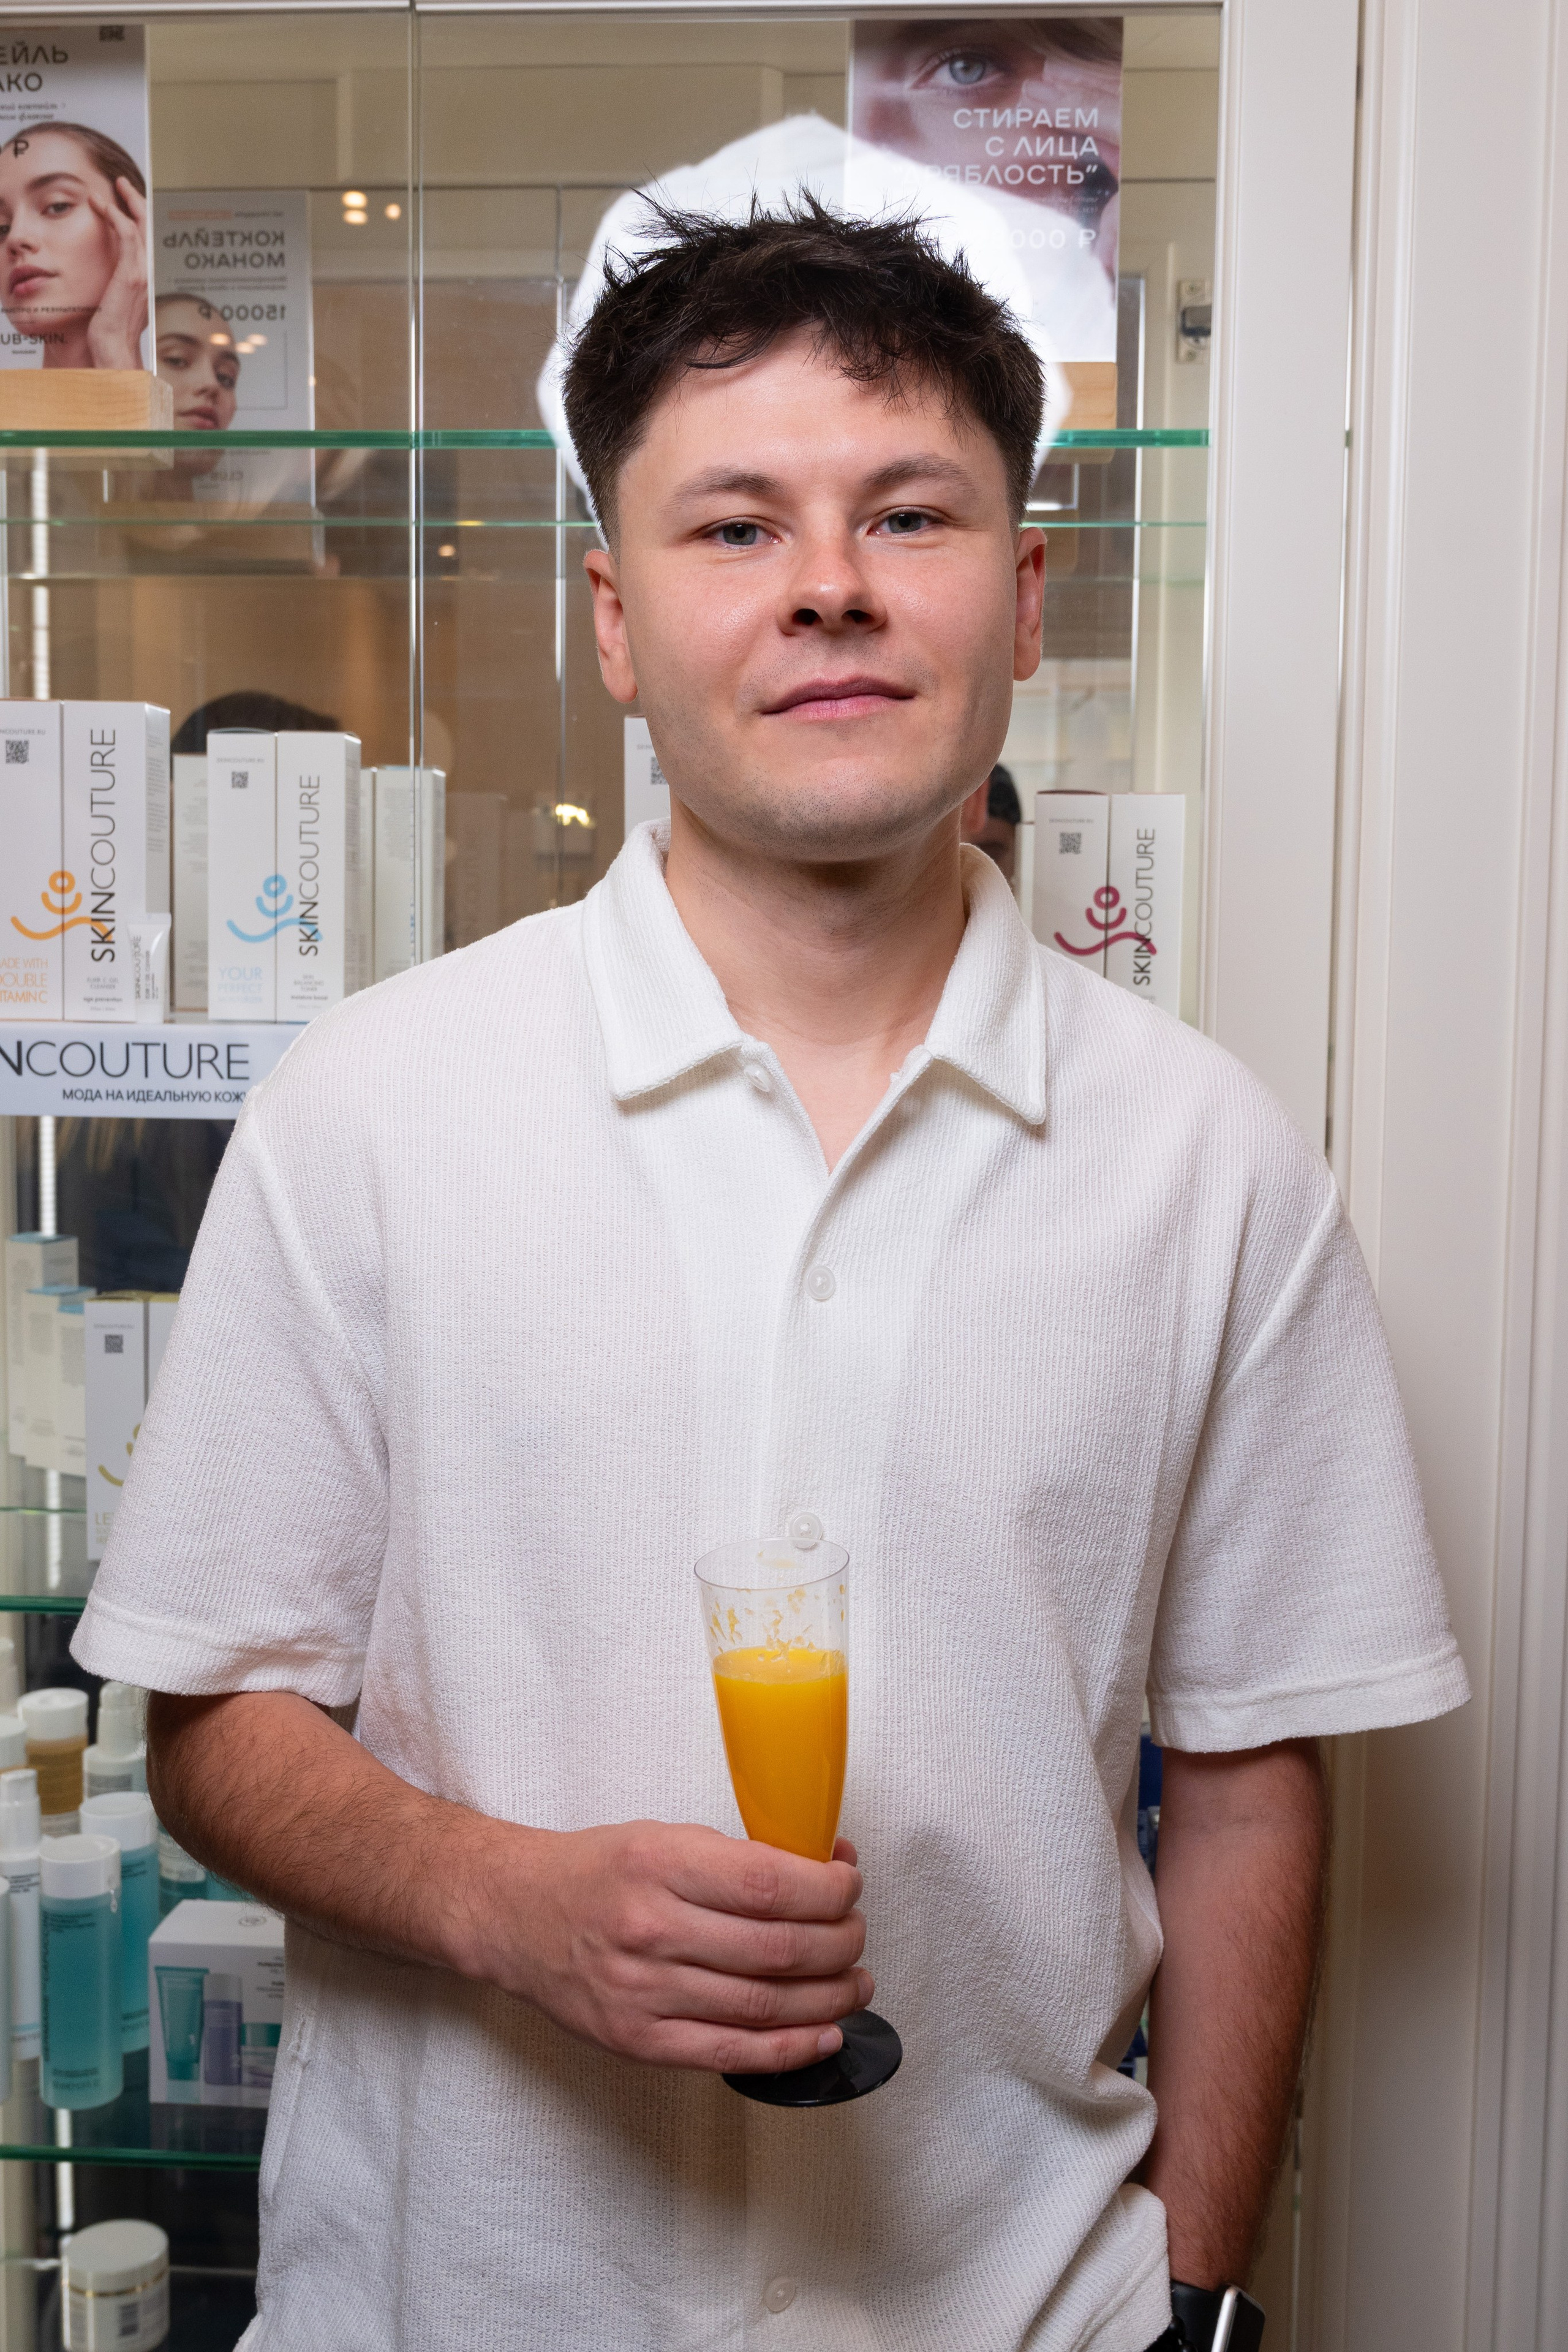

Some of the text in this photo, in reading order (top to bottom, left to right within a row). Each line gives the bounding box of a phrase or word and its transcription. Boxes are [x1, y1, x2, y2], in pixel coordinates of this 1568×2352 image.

[0, 72, 43, 92] КО
[953, 107, 1099, 129] СТИРАЕМ
[985, 136, 1099, 160] С ЛИЦА
[90, 729, 116, 963] SKINCOUTURE
[299, 774, 320, 957] SKINCOUTURE
[1133, 827, 1155, 986] SKINCOUTURE
[23, 957, 48, 969] WITH
[0, 973, 47, 988] OUBLE
[62, 1088, 246, 1103] МОДА НА ИДЕАЛЬНУЮ КОЖ
